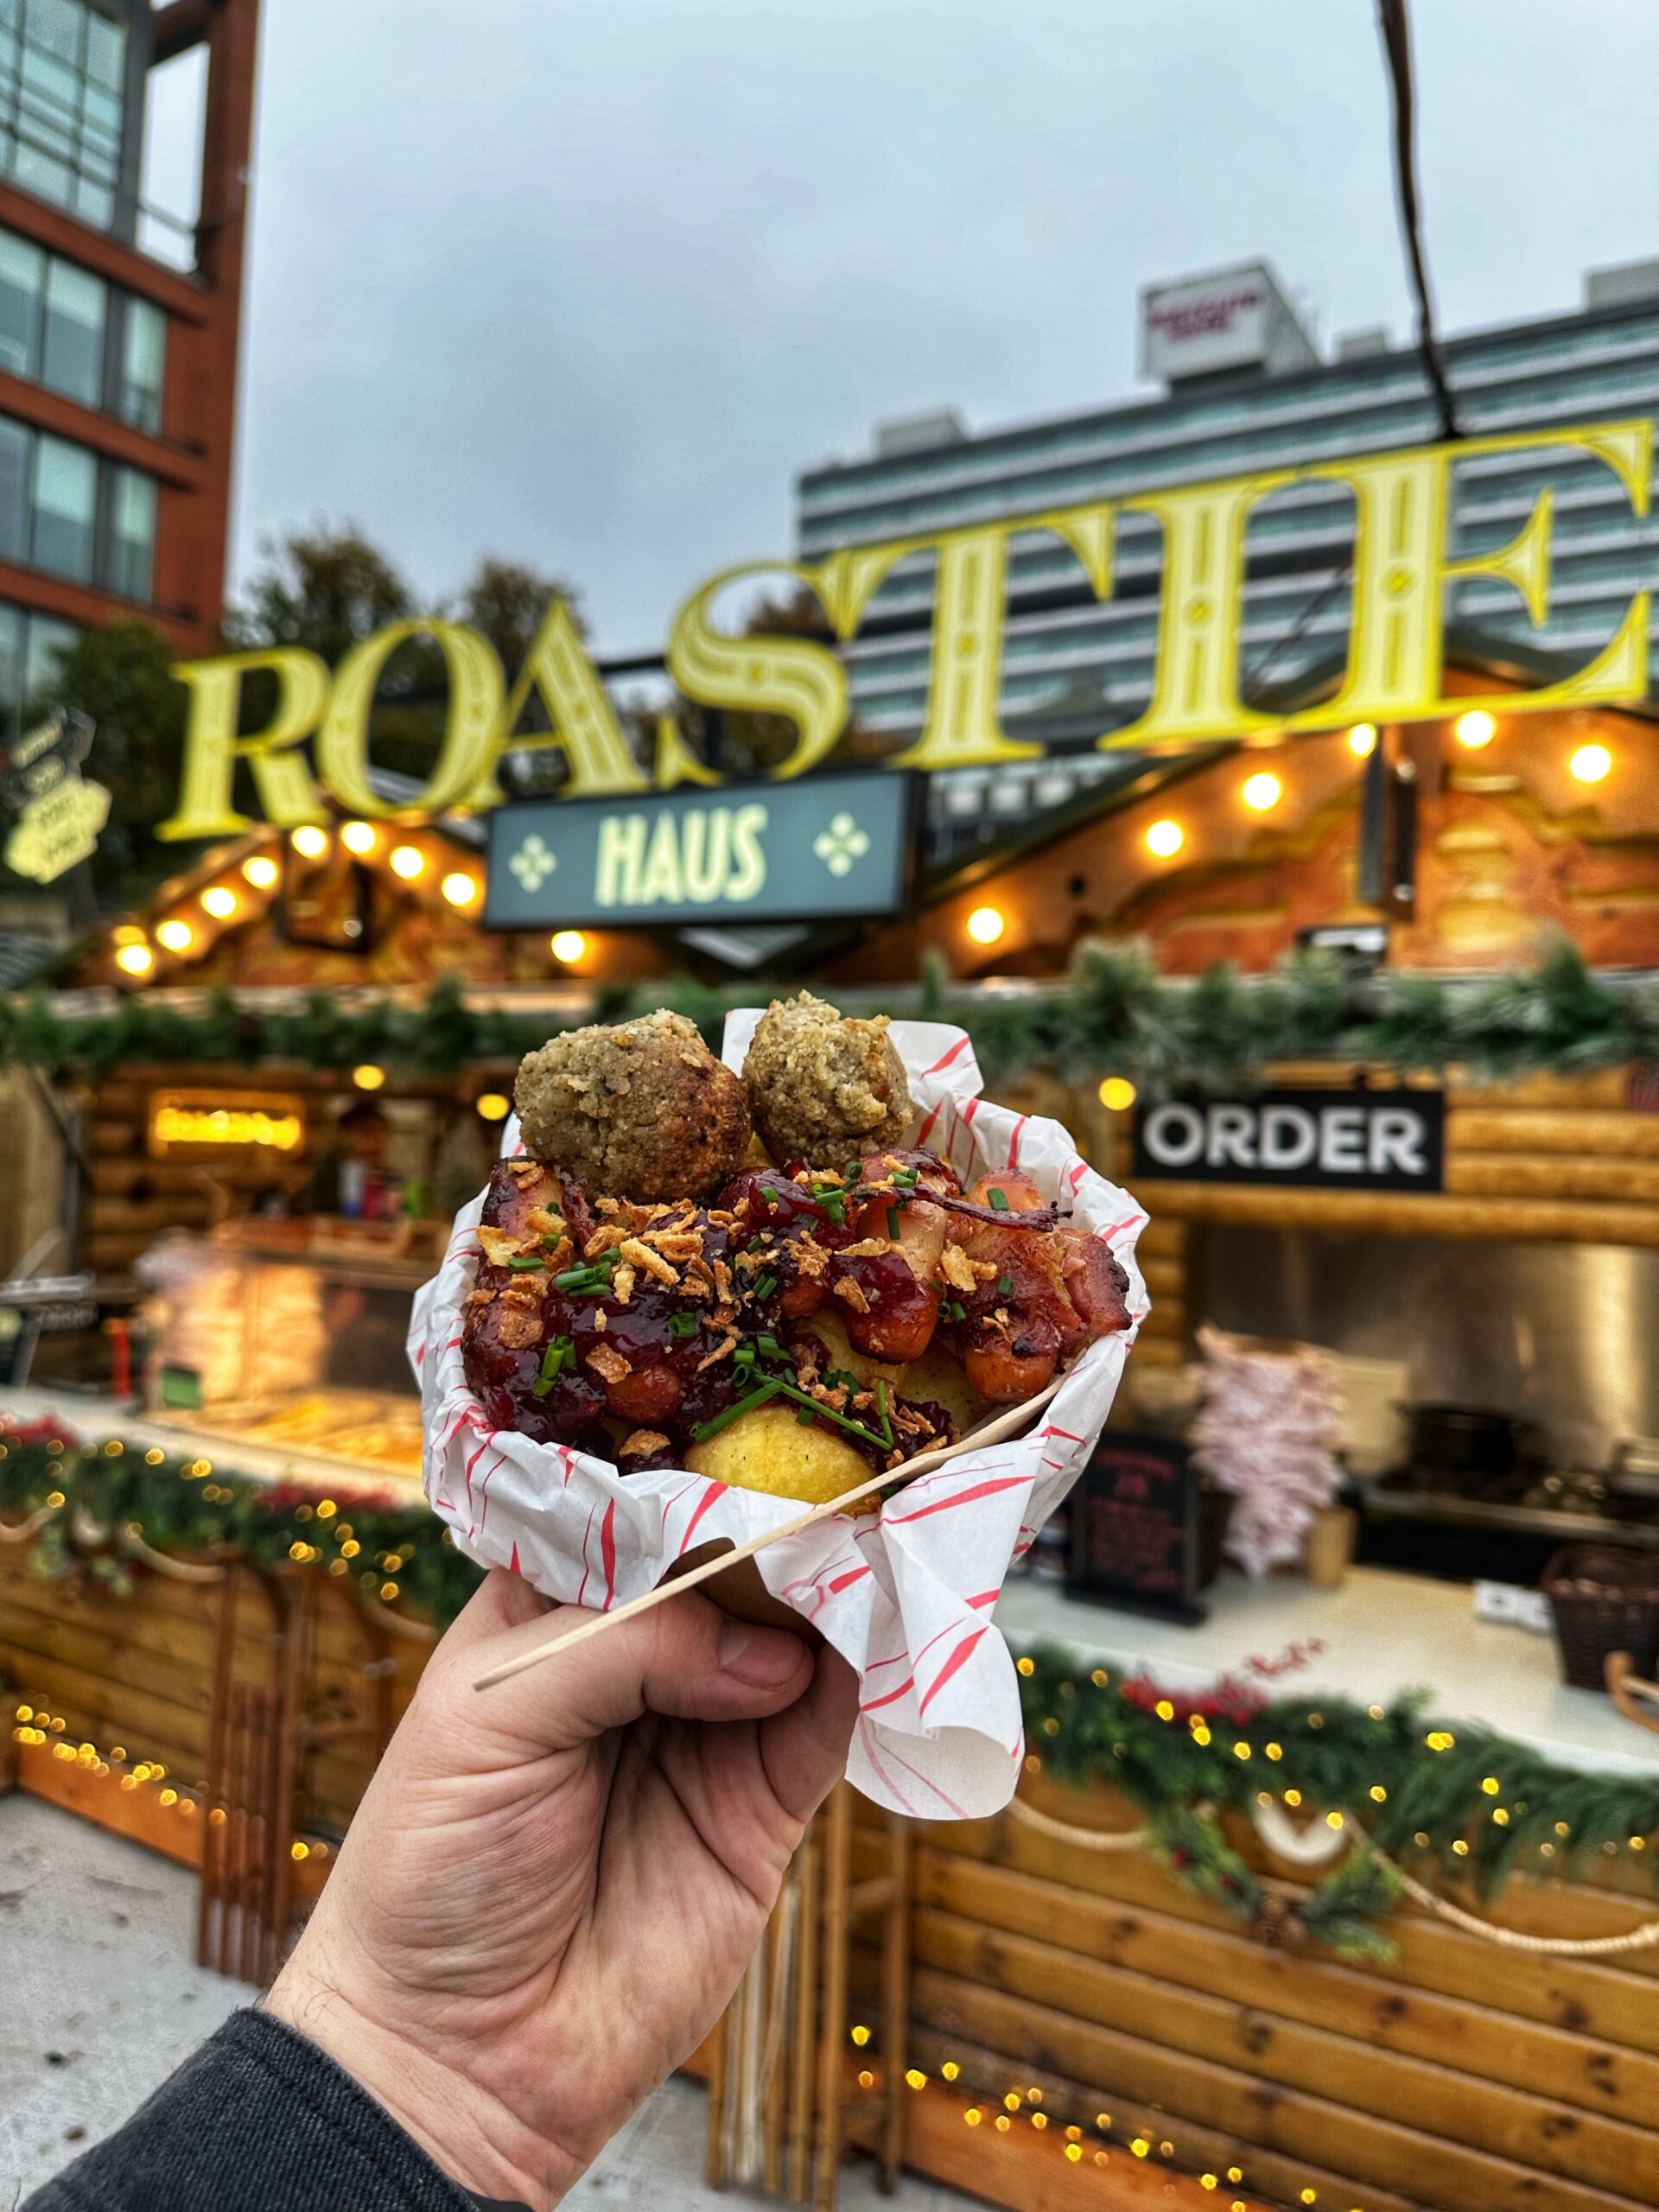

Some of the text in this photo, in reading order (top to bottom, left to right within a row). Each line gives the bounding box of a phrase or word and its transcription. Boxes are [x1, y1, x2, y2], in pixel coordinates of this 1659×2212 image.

[156, 418, 1652, 841] ROASTIE
[594, 803, 768, 906] HAUS
[1142, 1103, 1427, 1175] ORDER
